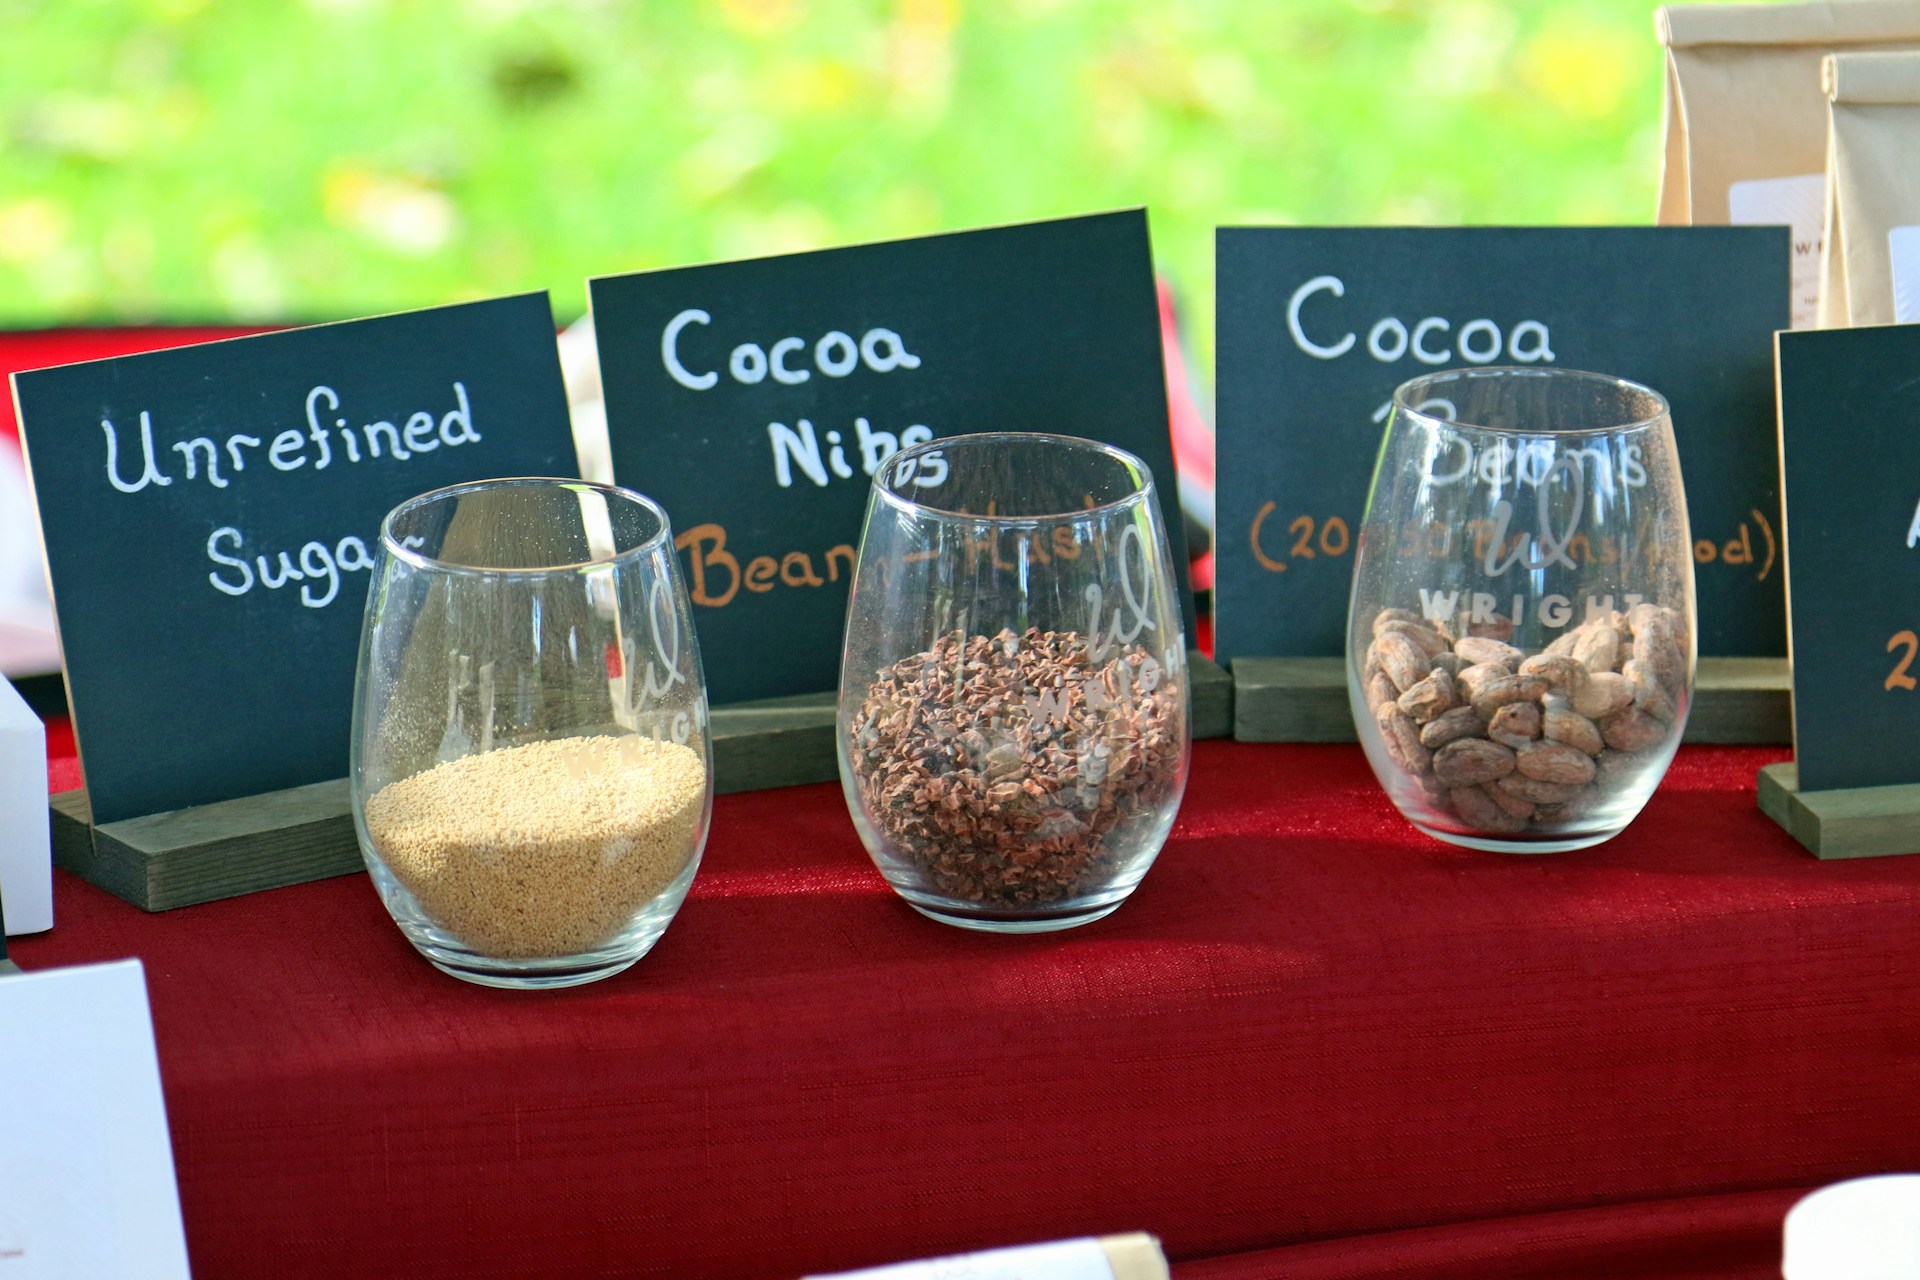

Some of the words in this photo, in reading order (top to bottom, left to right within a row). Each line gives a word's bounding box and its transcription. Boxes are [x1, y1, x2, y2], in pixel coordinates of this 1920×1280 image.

[661, 309, 921, 390] Cocoa
[1286, 275, 1555, 364] Cocoa
[101, 382, 481, 493] Unrefined
[767, 417, 949, 488] Nibs
[674, 523, 858, 607] Bean
[1419, 588, 1643, 628] WRIGHT
